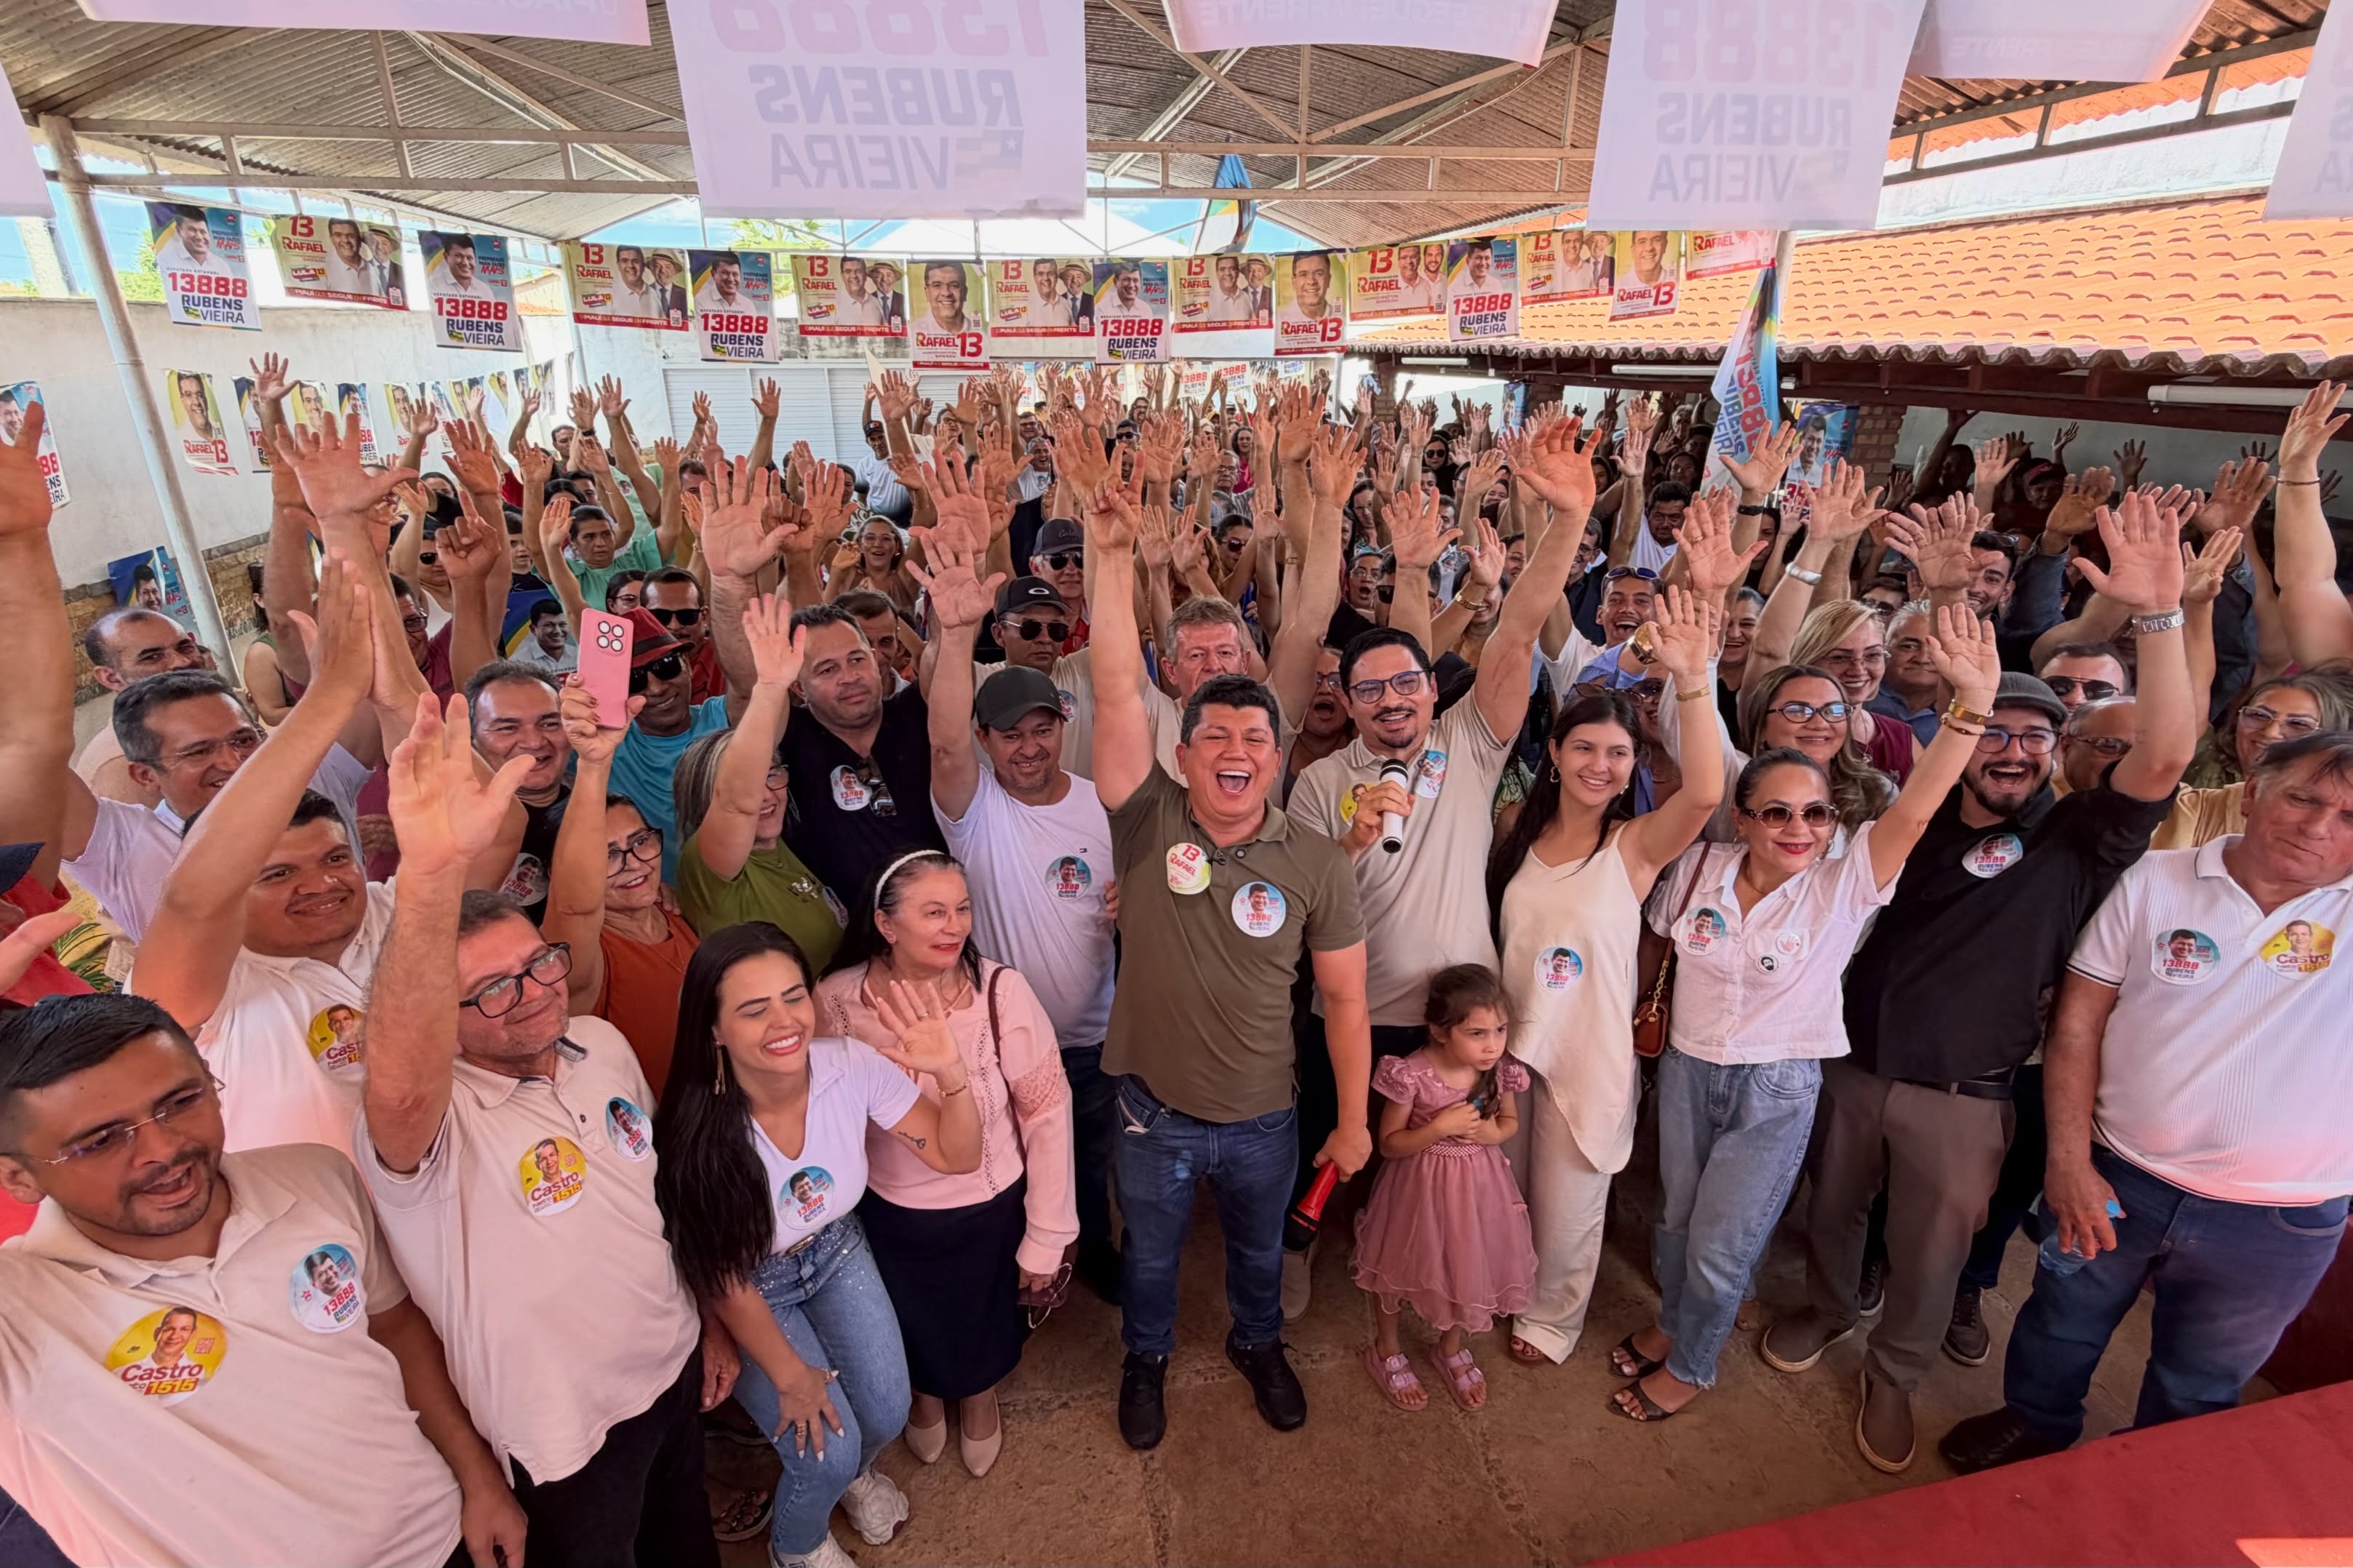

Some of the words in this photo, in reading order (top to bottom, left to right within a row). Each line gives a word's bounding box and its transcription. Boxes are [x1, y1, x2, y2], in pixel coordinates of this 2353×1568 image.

[289, 215, 314, 237] 13
[282, 236, 327, 253] RAFAEL
[1534, 233, 1552, 251] 13
[1693, 235, 1735, 252] RAFAEL
[580, 242, 604, 265] 13
[1367, 248, 1393, 273] 13
[1527, 252, 1557, 263] RAFAEL
[576, 264, 613, 279] RAFAEL
[807, 256, 828, 276] 13
[1001, 260, 1022, 280] 13
[1186, 257, 1205, 276] 13
[168, 272, 248, 298] 13888
[802, 278, 837, 290] RAFAEL
[996, 281, 1030, 293] RAFAEL
[1179, 277, 1212, 289] RAFAEL
[1357, 277, 1401, 293] RAFAEL
[1617, 288, 1653, 302] RAFAEL
[1653, 281, 1676, 306] 13
[182, 295, 244, 311] RUBENS
[434, 297, 508, 321] 13888
[1453, 293, 1512, 315] 13888
[200, 308, 245, 324] VIEIRA
[700, 313, 769, 334] 13888
[1460, 311, 1507, 327] RUBENS
[446, 319, 503, 333] RUBENS
[1100, 319, 1163, 337] 13888
[1281, 321, 1319, 335] RAFAEL
[1318, 317, 1343, 343] 13
[1473, 323, 1507, 335] VIEIRA
[463, 332, 505, 345] VIEIRA
[711, 334, 764, 346] RUBENS
[916, 332, 959, 348] RAFAEL
[956, 332, 983, 358] 13
[1108, 337, 1157, 349] RUBENS
[727, 346, 764, 358] VIEIRA
[1122, 349, 1156, 359] VIEIRA
[183, 439, 215, 455] RAFAEL
[212, 440, 229, 463] 13
[1181, 844, 1200, 862] 13
[1169, 852, 1196, 876] RAFAEL
[2162, 959, 2200, 970] 13888
[2276, 953, 2329, 964] Castro
[326, 1041, 362, 1060] Cast
[531, 1172, 579, 1201] Castro
[556, 1182, 582, 1202] 1515
[323, 1281, 356, 1316] 13888
[334, 1294, 357, 1320] RUBENS
[121, 1363, 204, 1382] Castro
[150, 1380, 195, 1393] 1515
